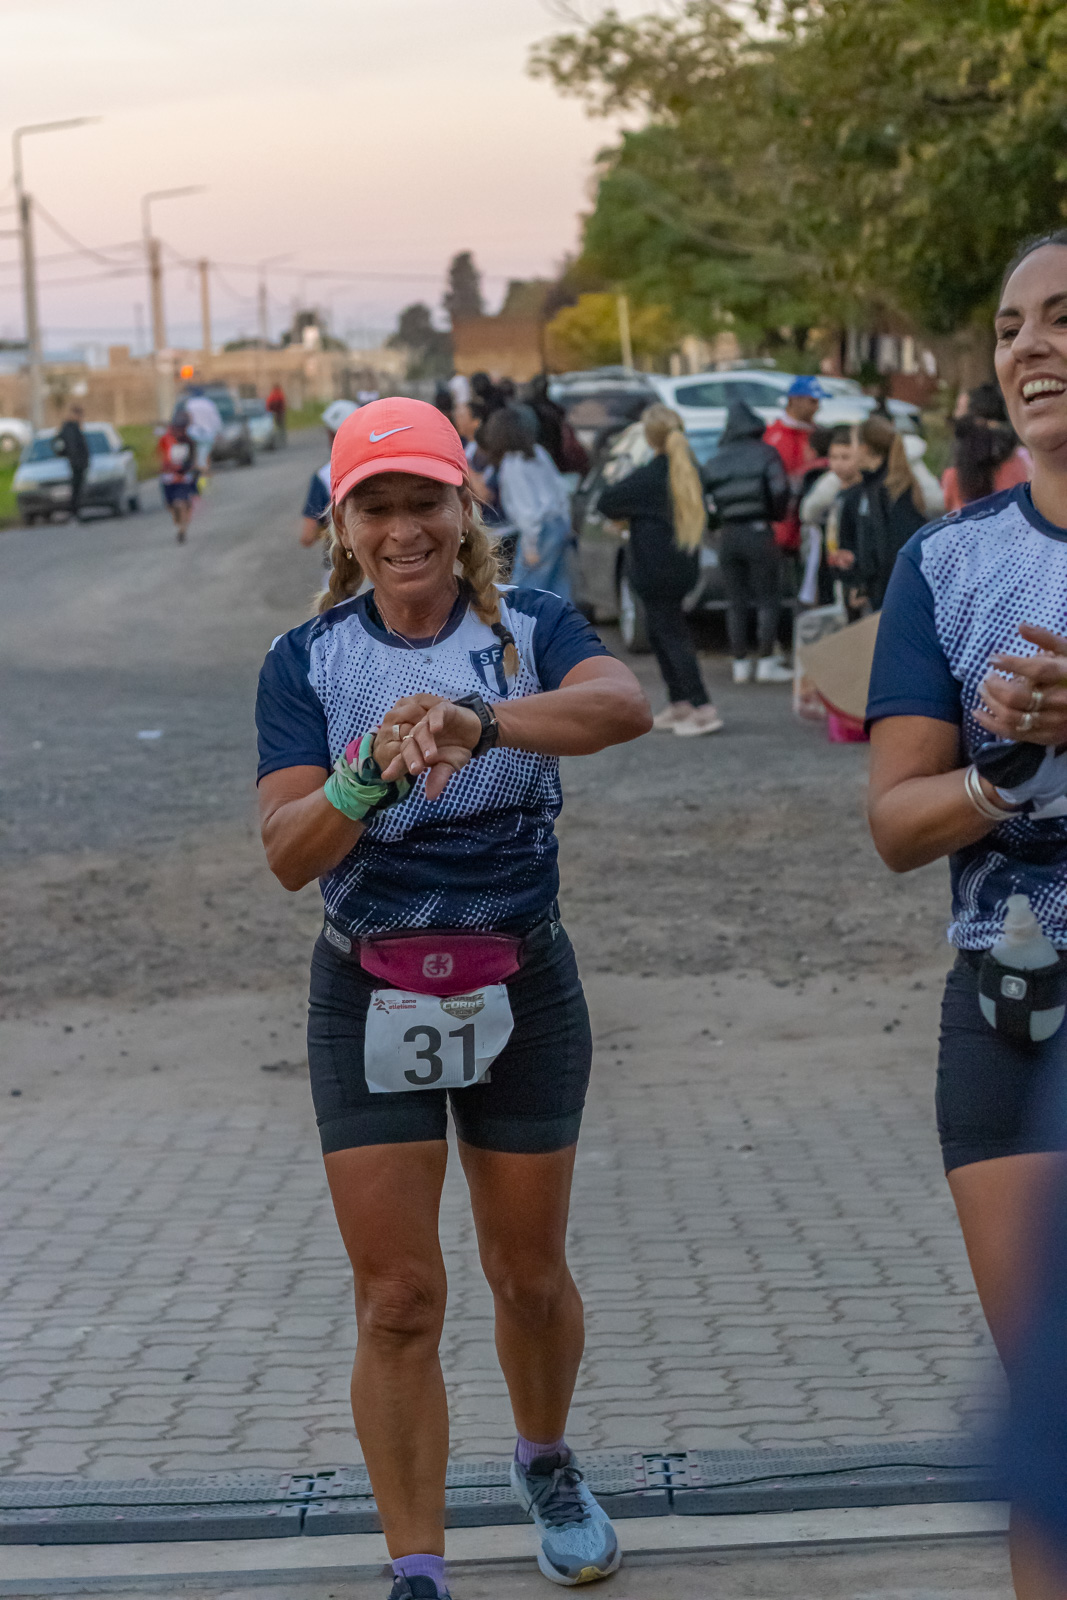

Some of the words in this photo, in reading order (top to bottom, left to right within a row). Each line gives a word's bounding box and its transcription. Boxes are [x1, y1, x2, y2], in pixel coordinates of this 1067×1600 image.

[479, 649, 506, 665] SF
[442, 1000, 484, 1010] CORRE
[403, 1023, 476, 1086] 31
